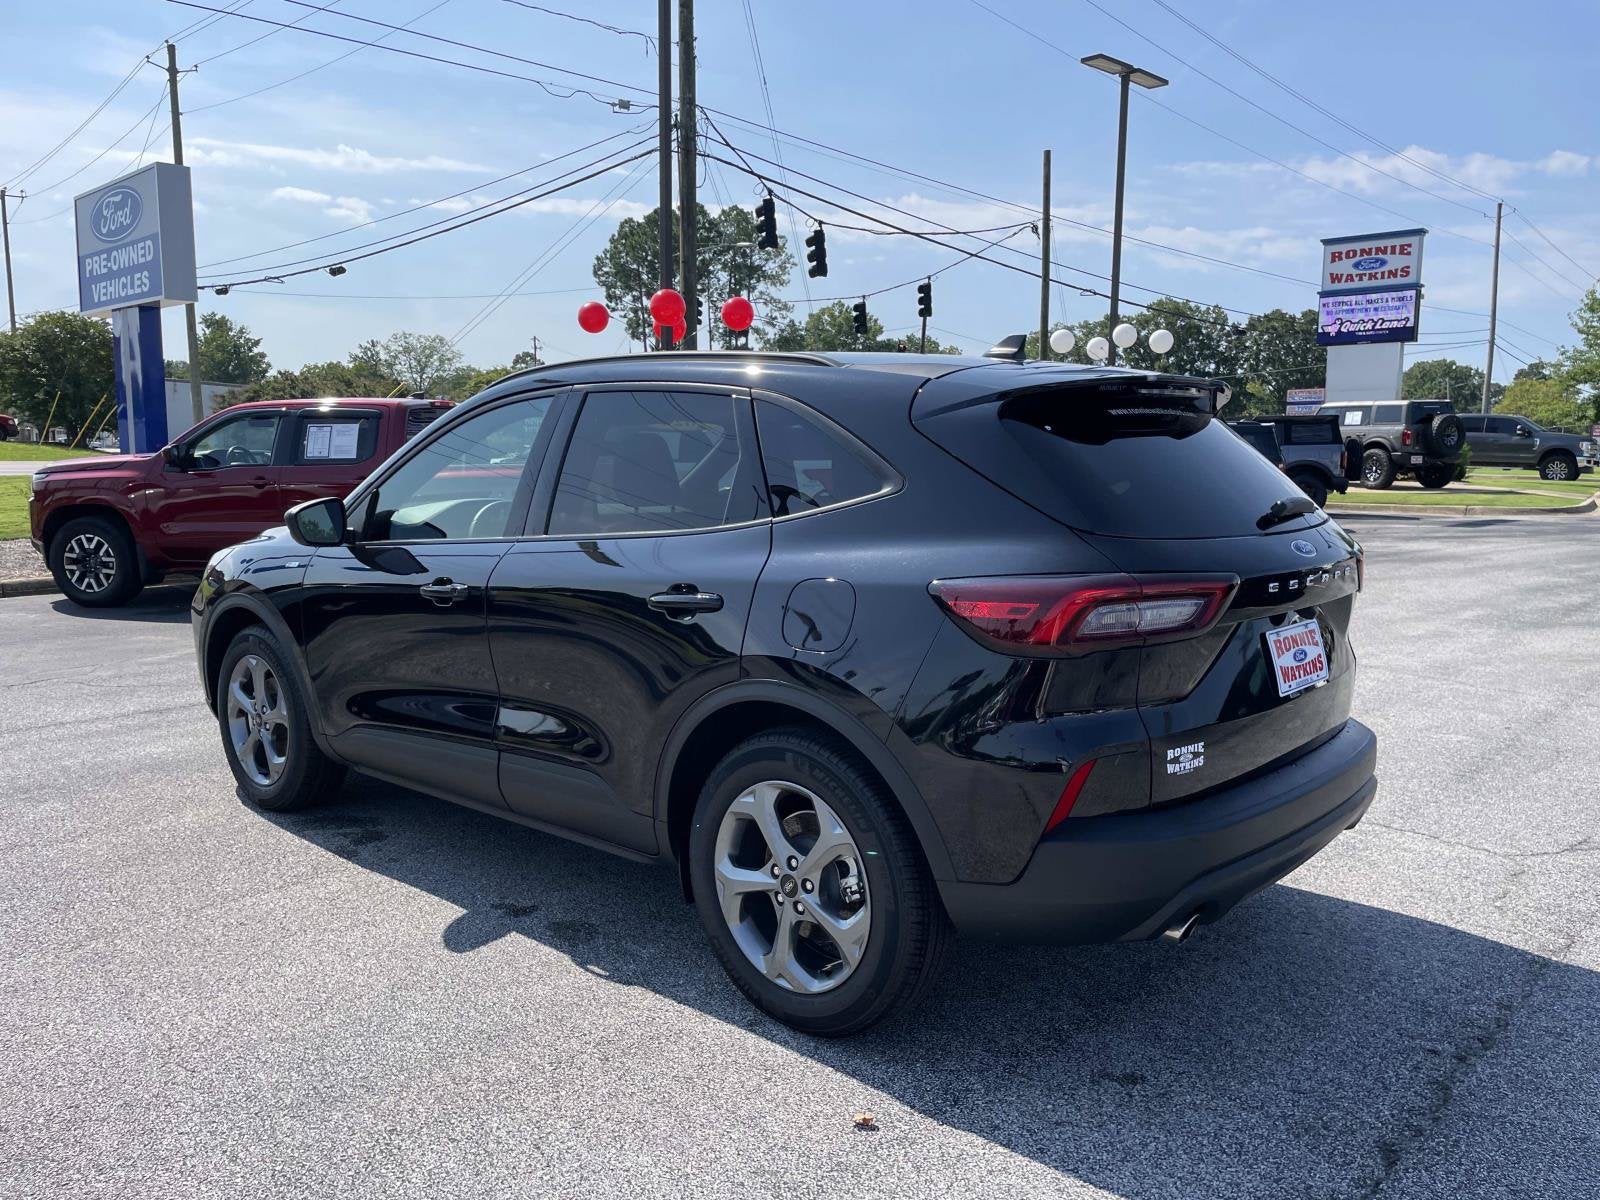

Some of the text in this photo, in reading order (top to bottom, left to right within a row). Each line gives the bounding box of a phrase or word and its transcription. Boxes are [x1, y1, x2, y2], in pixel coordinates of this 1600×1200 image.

[100, 194, 132, 234] Ford
[85, 239, 154, 277] PRE-OWNED
[1330, 243, 1412, 264] RONNIE
[1329, 265, 1411, 284] WATKINS
[1358, 259, 1381, 270] Ford
[92, 270, 150, 303] VEHICLES
[1365, 296, 1384, 304] MAKES
[1391, 295, 1413, 303] MODELS
[1341, 319, 1405, 332] Quick Lane
[1268, 567, 1352, 592] ESCAPE
[1273, 629, 1319, 658] RONNIE
[1280, 653, 1324, 684] WATKINS
[1167, 741, 1205, 761] RONNIE
[1167, 755, 1204, 774] WATKINS
